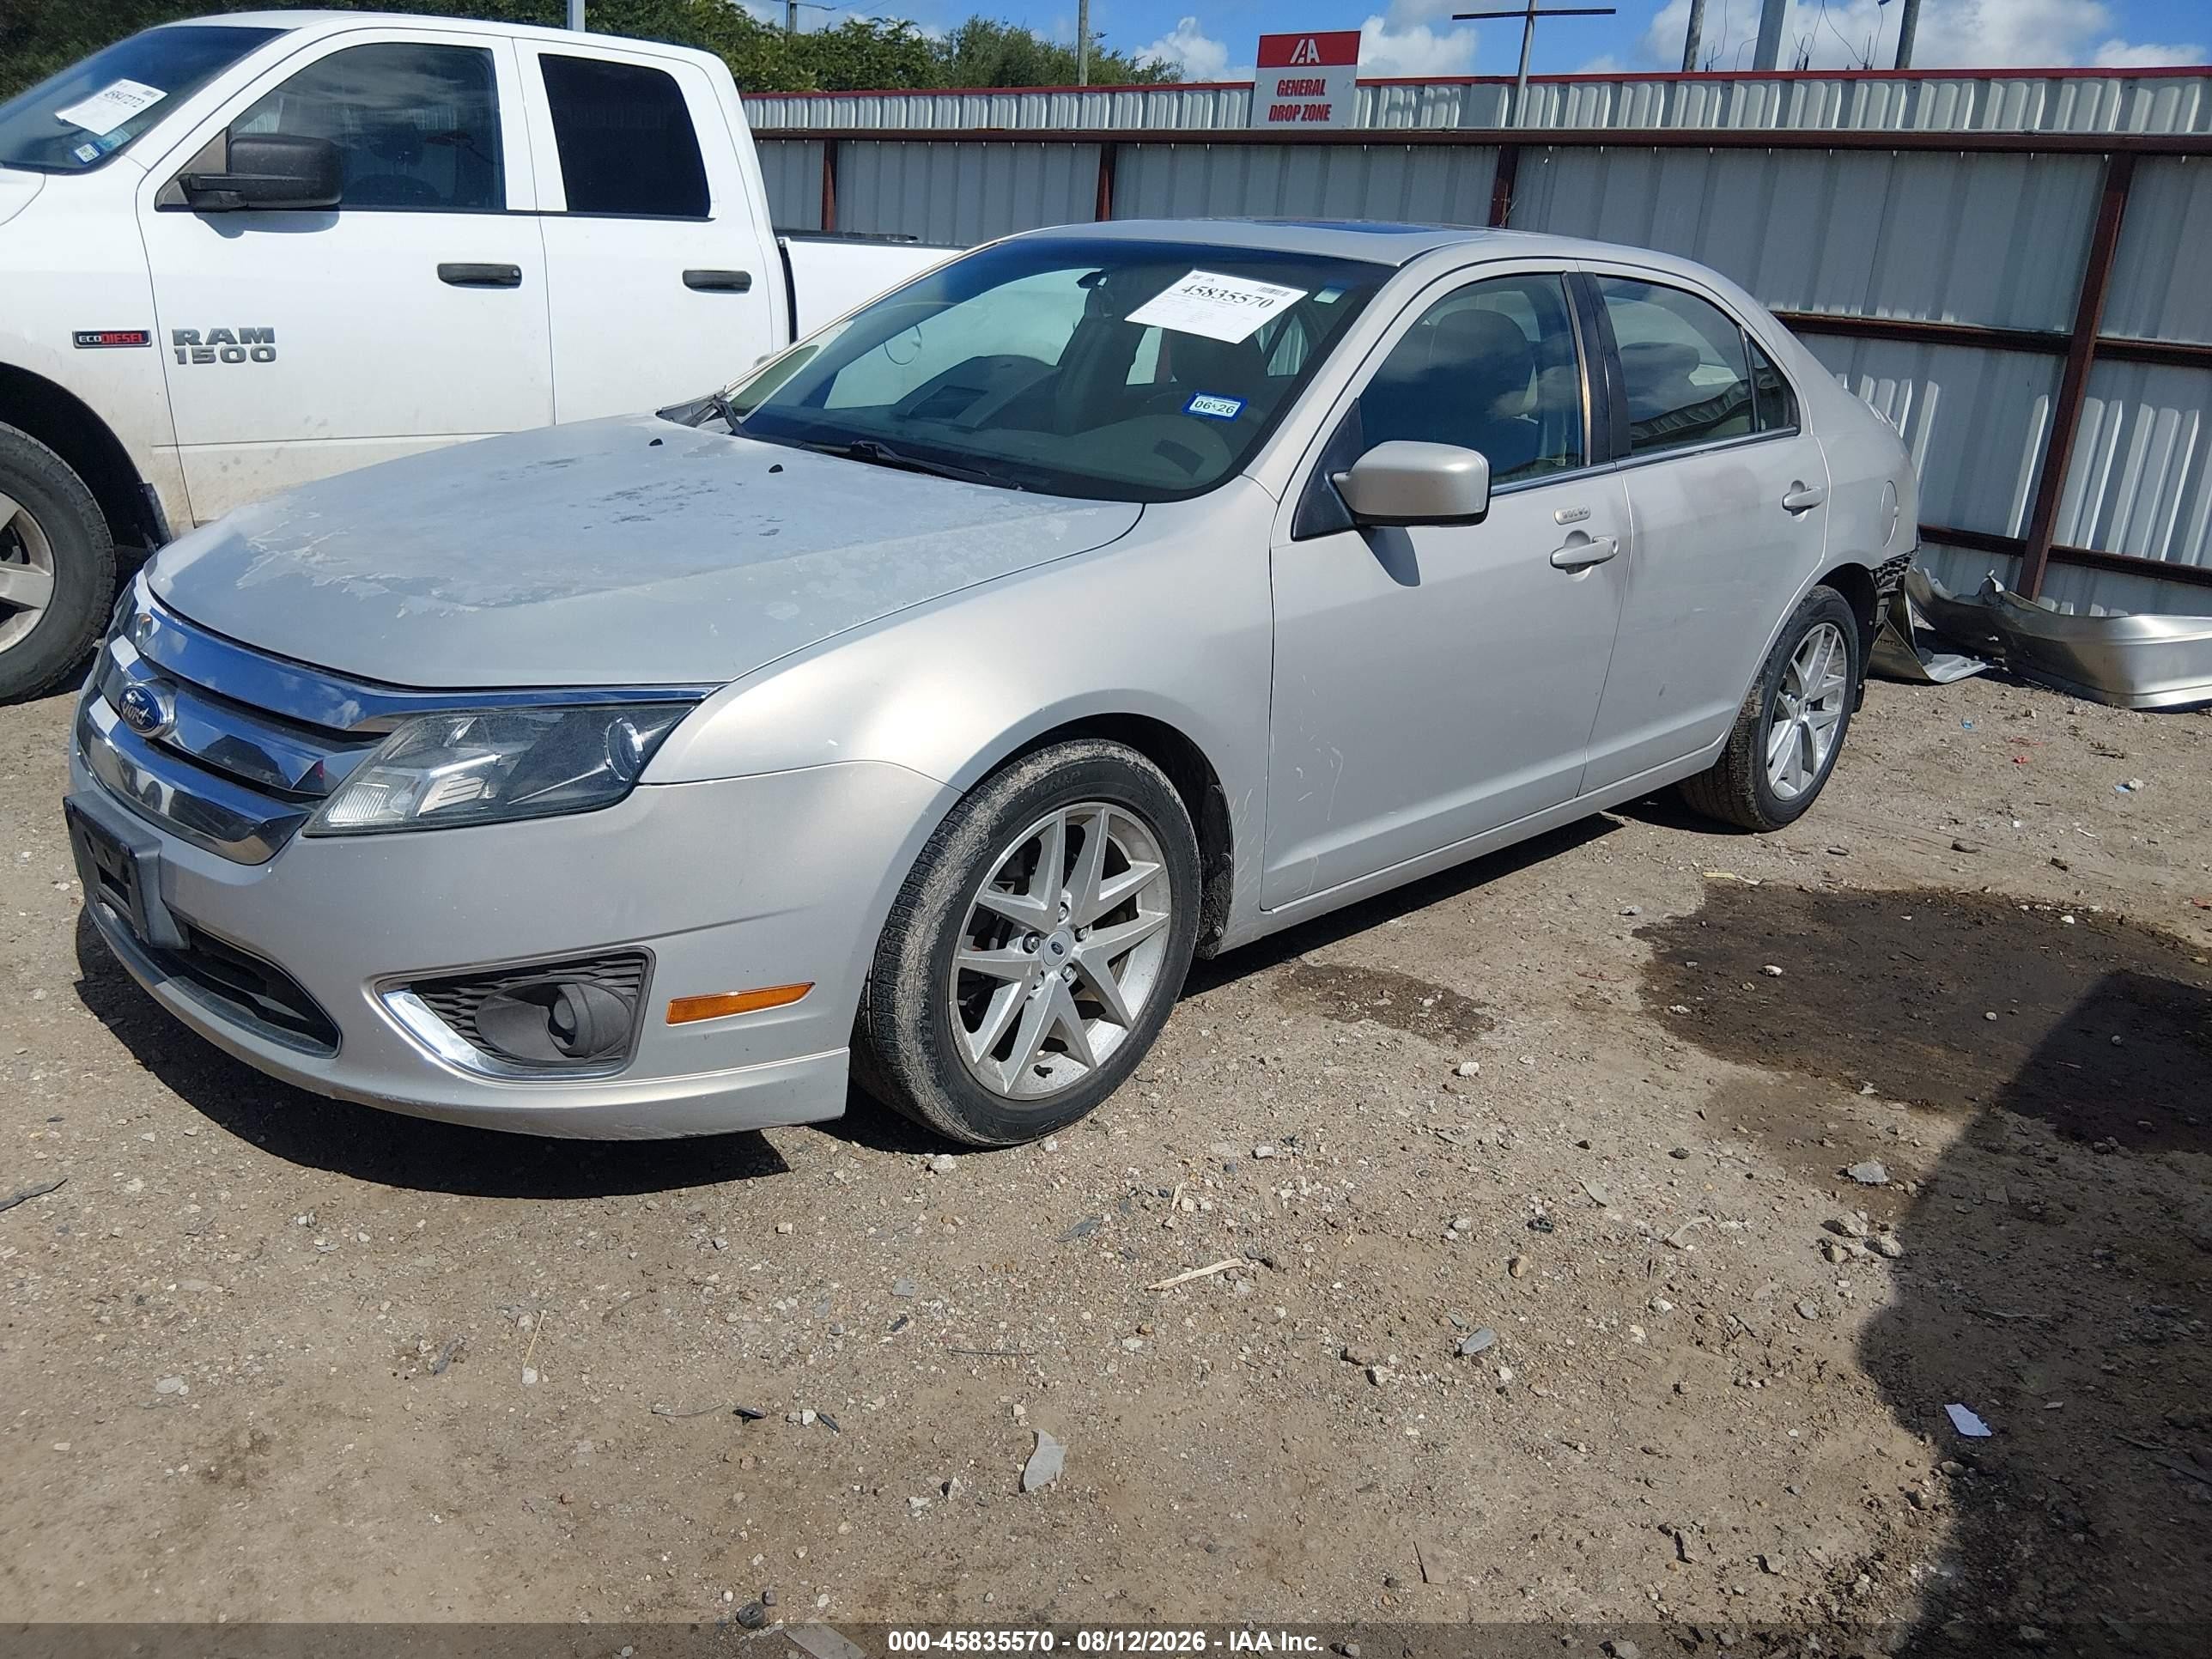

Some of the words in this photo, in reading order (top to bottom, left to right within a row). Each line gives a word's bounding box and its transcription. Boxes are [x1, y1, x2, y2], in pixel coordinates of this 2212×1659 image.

[1277, 78, 1327, 97] GENERAL
[1268, 105, 1301, 122] DROP
[1301, 103, 1332, 122] ZONE
[1181, 284, 1275, 309] 45835570
[78, 333, 145, 345] ECODIESEL
[172, 327, 276, 346] RAM
[173, 345, 277, 365] 1500
[1194, 400, 1212, 410] 06
[1216, 404, 1236, 414] 26
[122, 690, 153, 726] Ford
